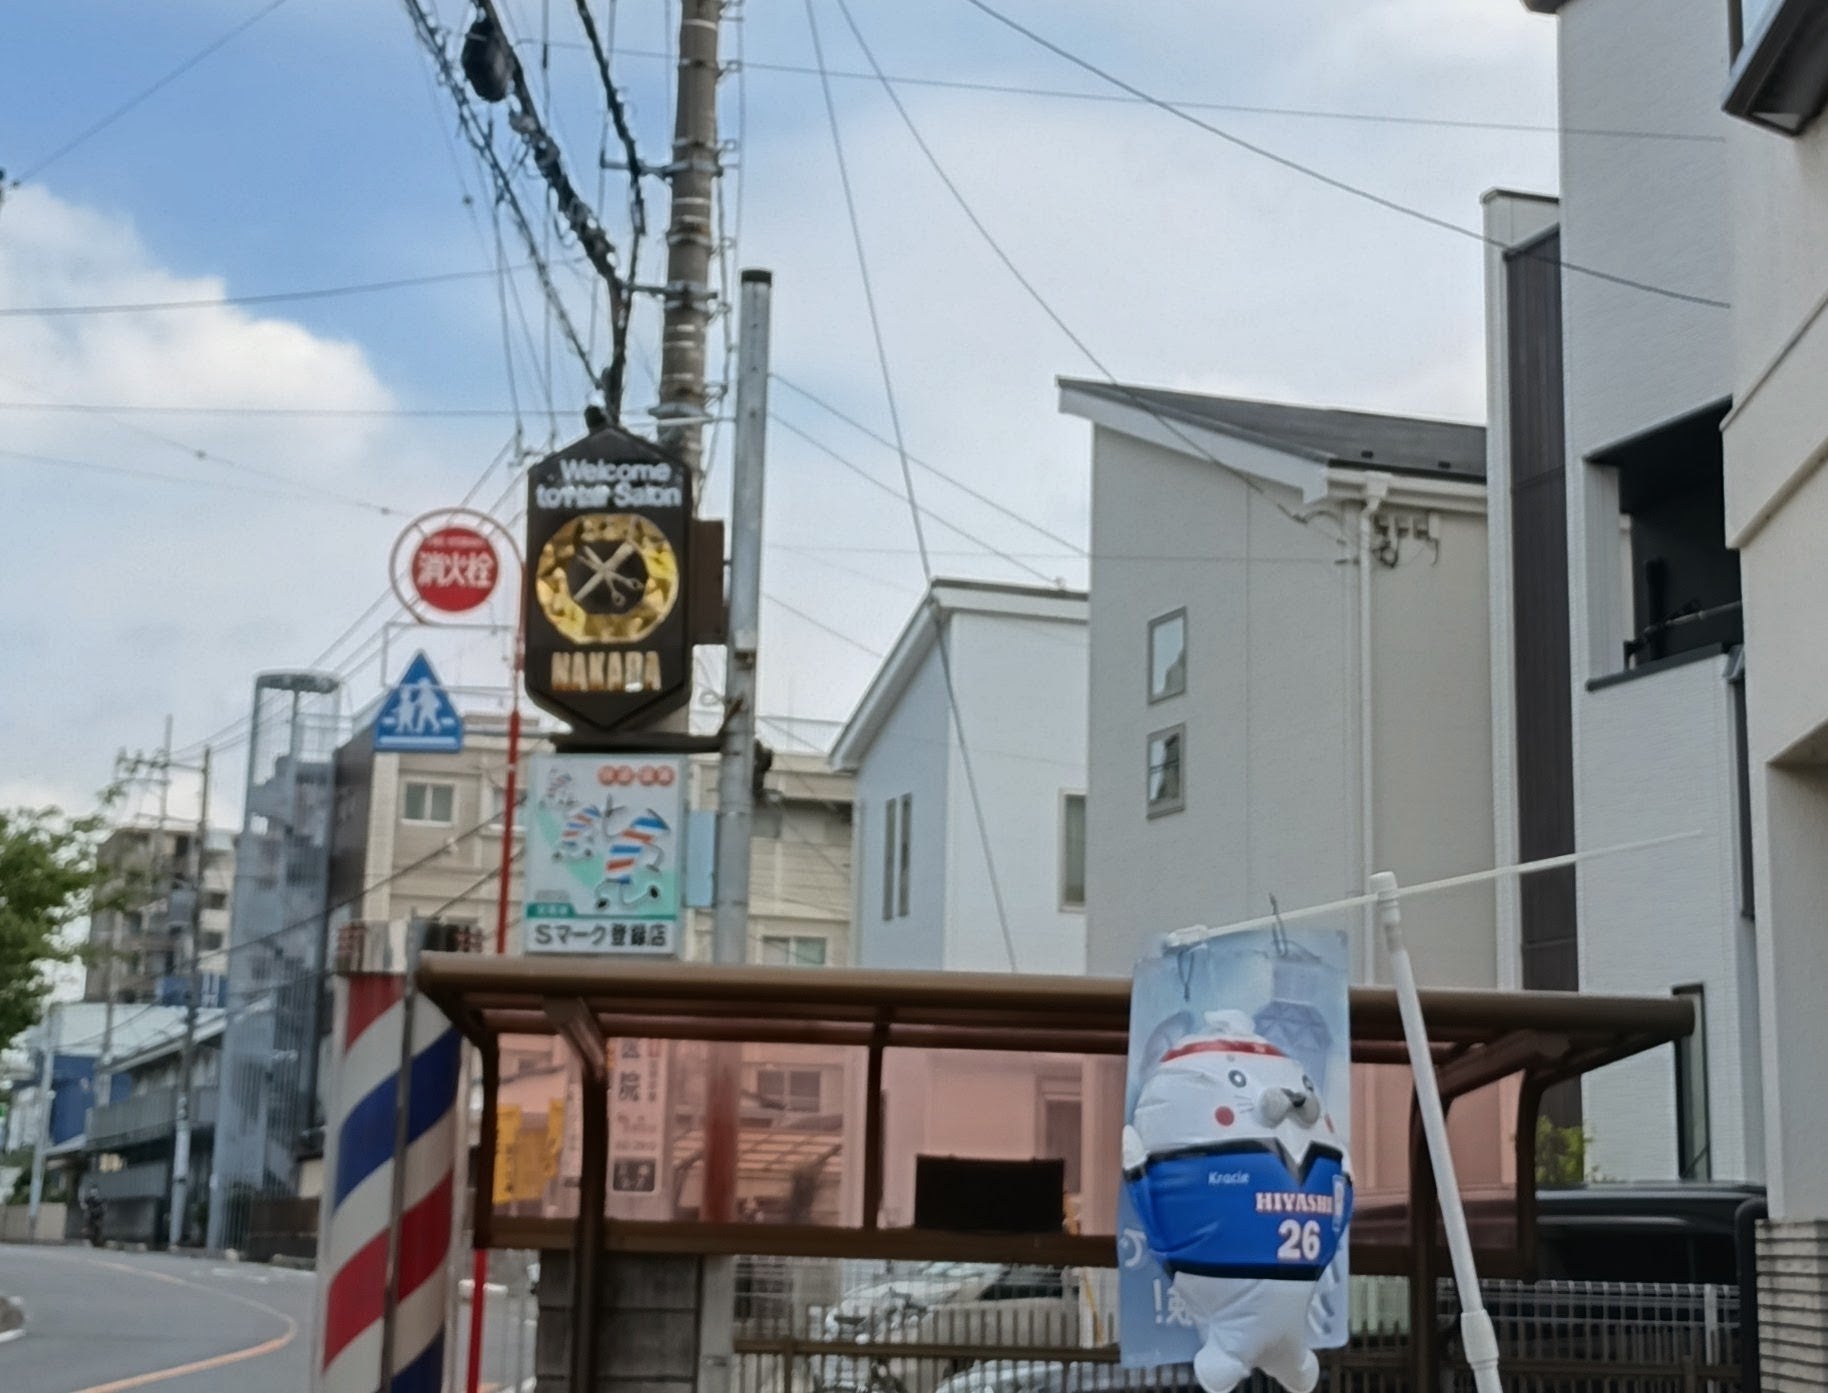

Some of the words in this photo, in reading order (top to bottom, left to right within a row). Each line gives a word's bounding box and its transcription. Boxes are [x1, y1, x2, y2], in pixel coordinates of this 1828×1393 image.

[560, 458, 672, 482] Welcome
[614, 482, 682, 507] Salon
[417, 551, 493, 587] 消火栓
[535, 923, 666, 946] Sマーク登録店
[1255, 1191, 1333, 1213] HIYASHI
[1277, 1219, 1320, 1260] 26
